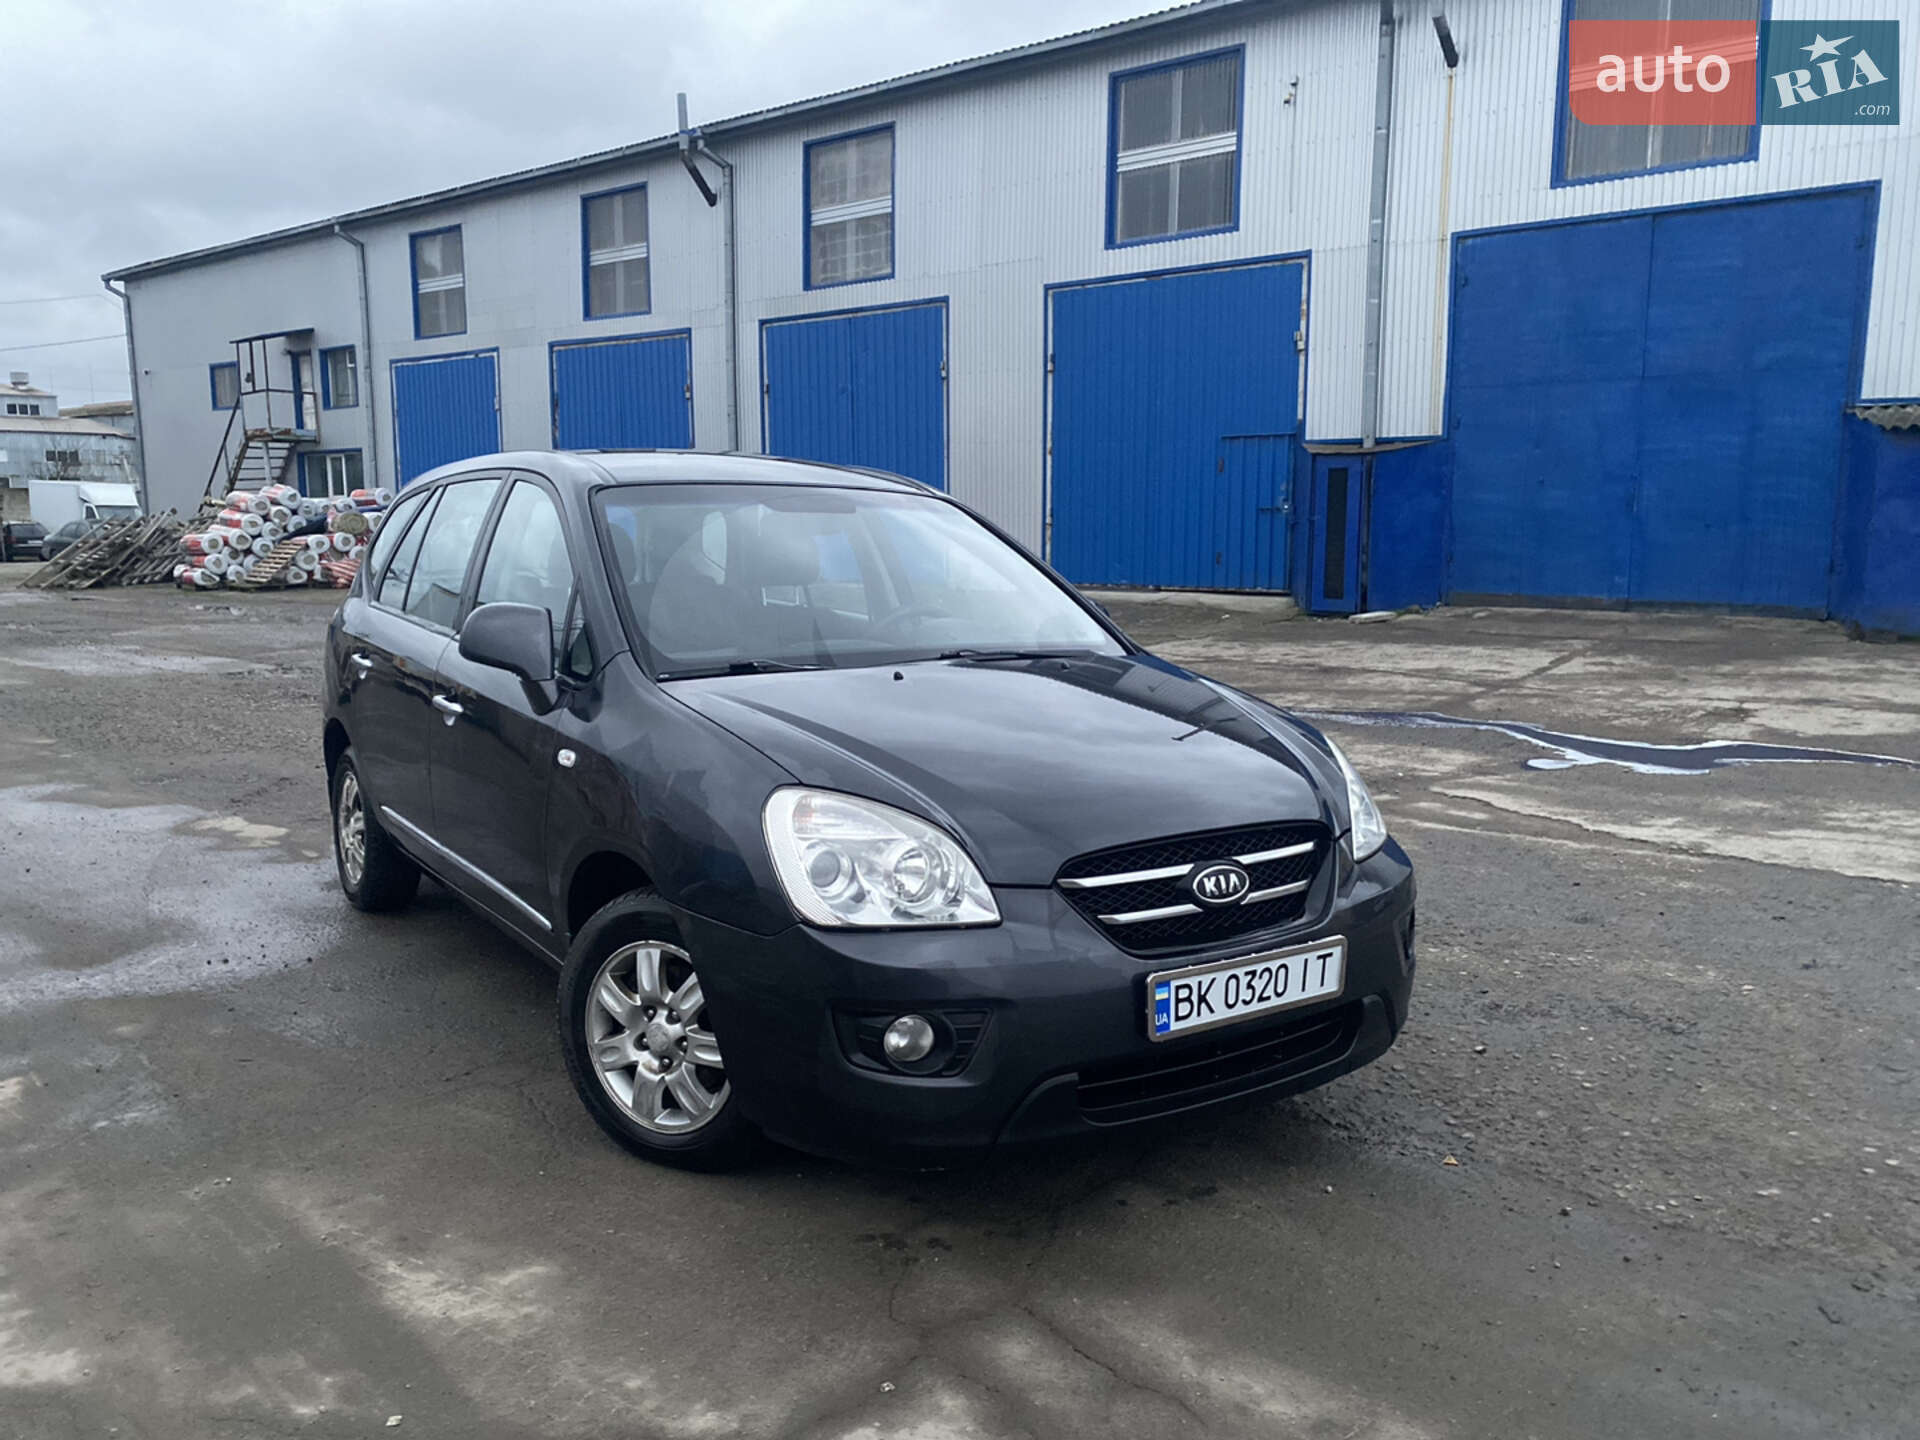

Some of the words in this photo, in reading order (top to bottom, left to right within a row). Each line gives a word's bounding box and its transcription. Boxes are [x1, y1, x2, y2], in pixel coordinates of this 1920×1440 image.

[1203, 872, 1241, 897] KIA
[1174, 976, 1217, 1022] BK
[1224, 963, 1289, 1010] 0320
[1301, 952, 1334, 993] IT
[1155, 1012, 1169, 1026] UA
